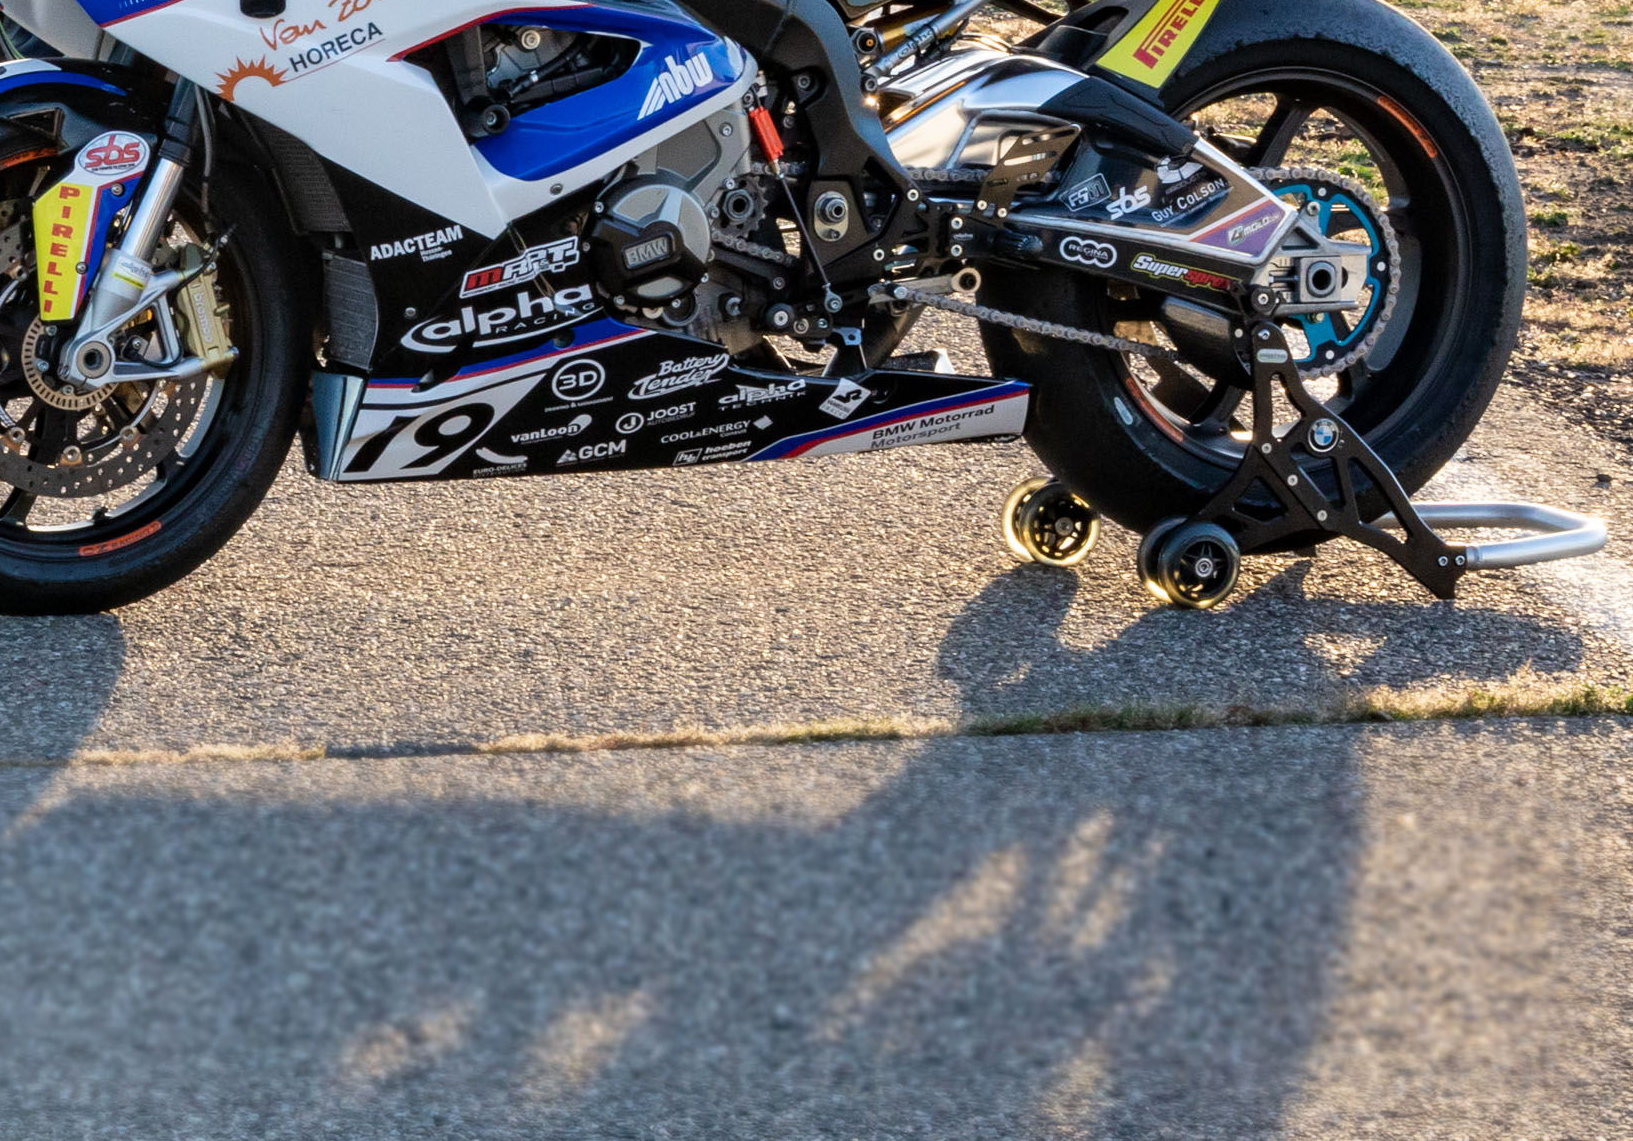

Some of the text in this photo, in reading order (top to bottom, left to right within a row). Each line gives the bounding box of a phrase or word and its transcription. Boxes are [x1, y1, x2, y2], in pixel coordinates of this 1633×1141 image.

[258, 17, 327, 52] Van
[288, 21, 383, 74] HORECA
[85, 134, 142, 168] sbs
[1106, 184, 1152, 221] sbs
[1151, 204, 1175, 223] GUY
[1176, 178, 1228, 211] COLSON
[41, 185, 81, 313] PIRELLI
[1067, 243, 1109, 259] REGINA
[192, 292, 213, 344] brembo
[421, 283, 594, 340] alpha
[495, 301, 596, 335] RACING
[557, 370, 599, 391] 3D
[658, 352, 729, 377] Battery
[629, 367, 720, 399] Tender
[718, 378, 807, 405] alpha
[646, 401, 697, 422] JOOST
[871, 404, 996, 440] BMW Motorrad
[660, 420, 752, 445] COOL&ENERGY
[870, 422, 962, 450] Motorsport
[578, 439, 627, 461] GCM
